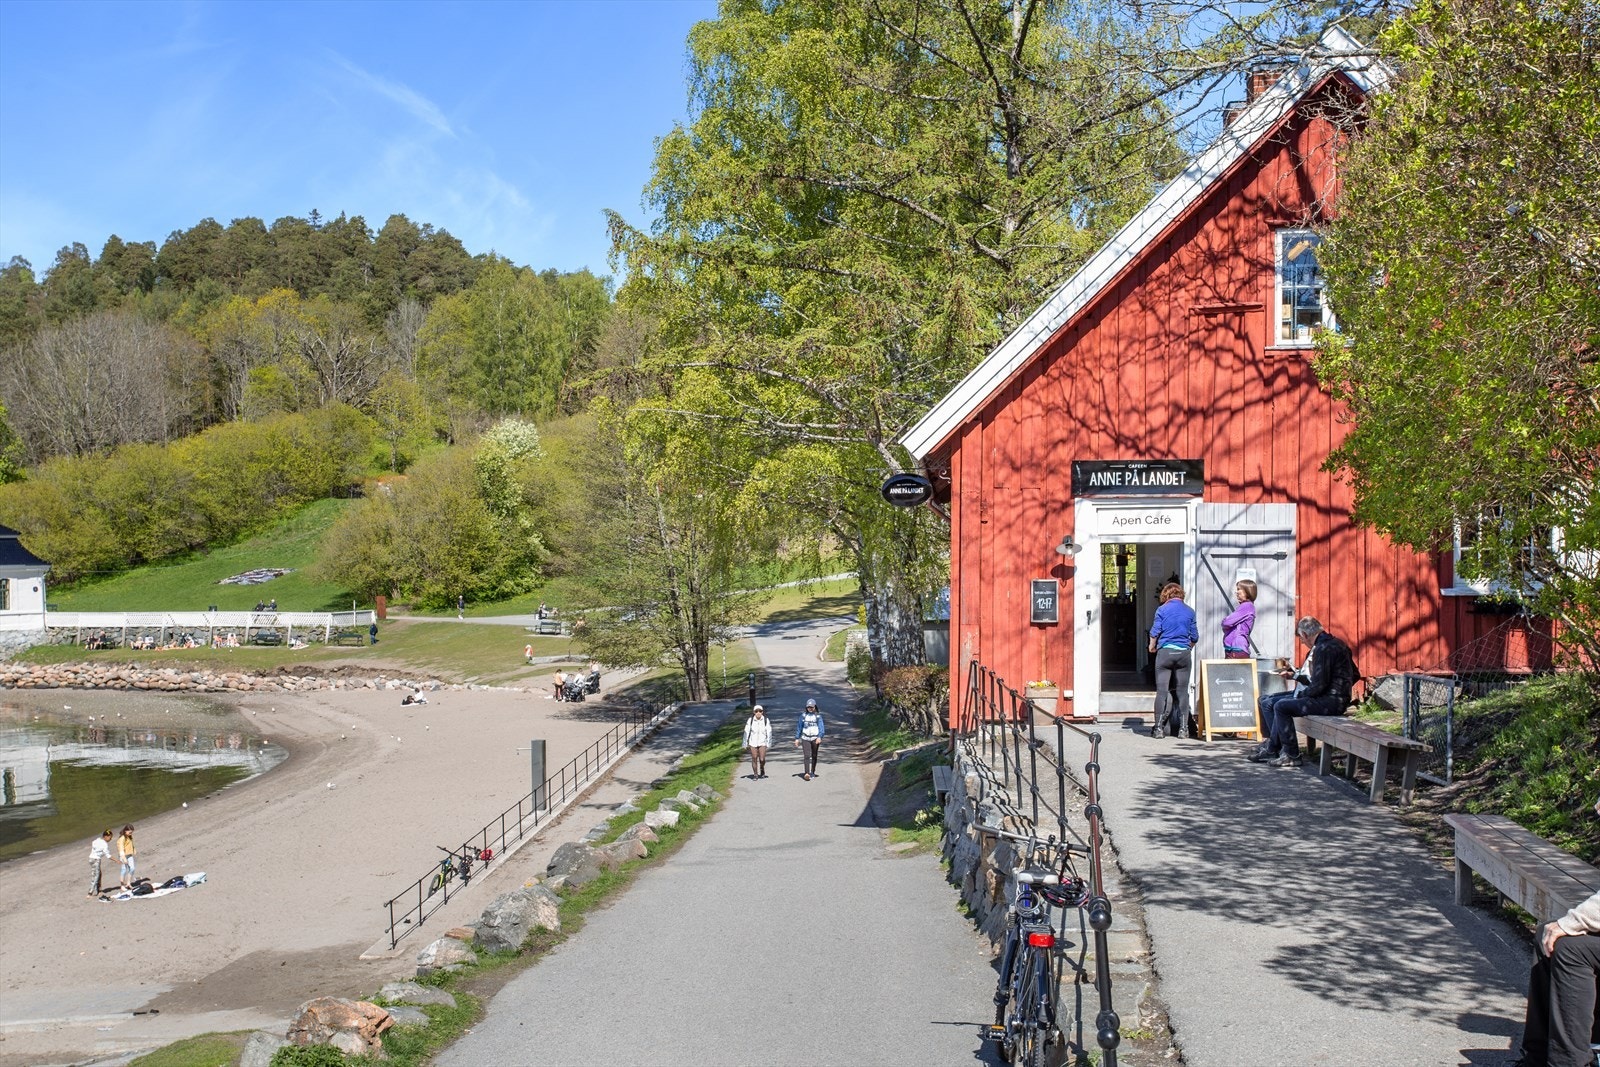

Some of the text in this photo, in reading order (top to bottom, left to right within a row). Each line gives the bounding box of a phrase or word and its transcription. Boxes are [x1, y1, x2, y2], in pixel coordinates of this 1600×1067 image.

[1089, 469, 1187, 486] ANNE PÅ LANDET
[1144, 514, 1172, 525] Café
